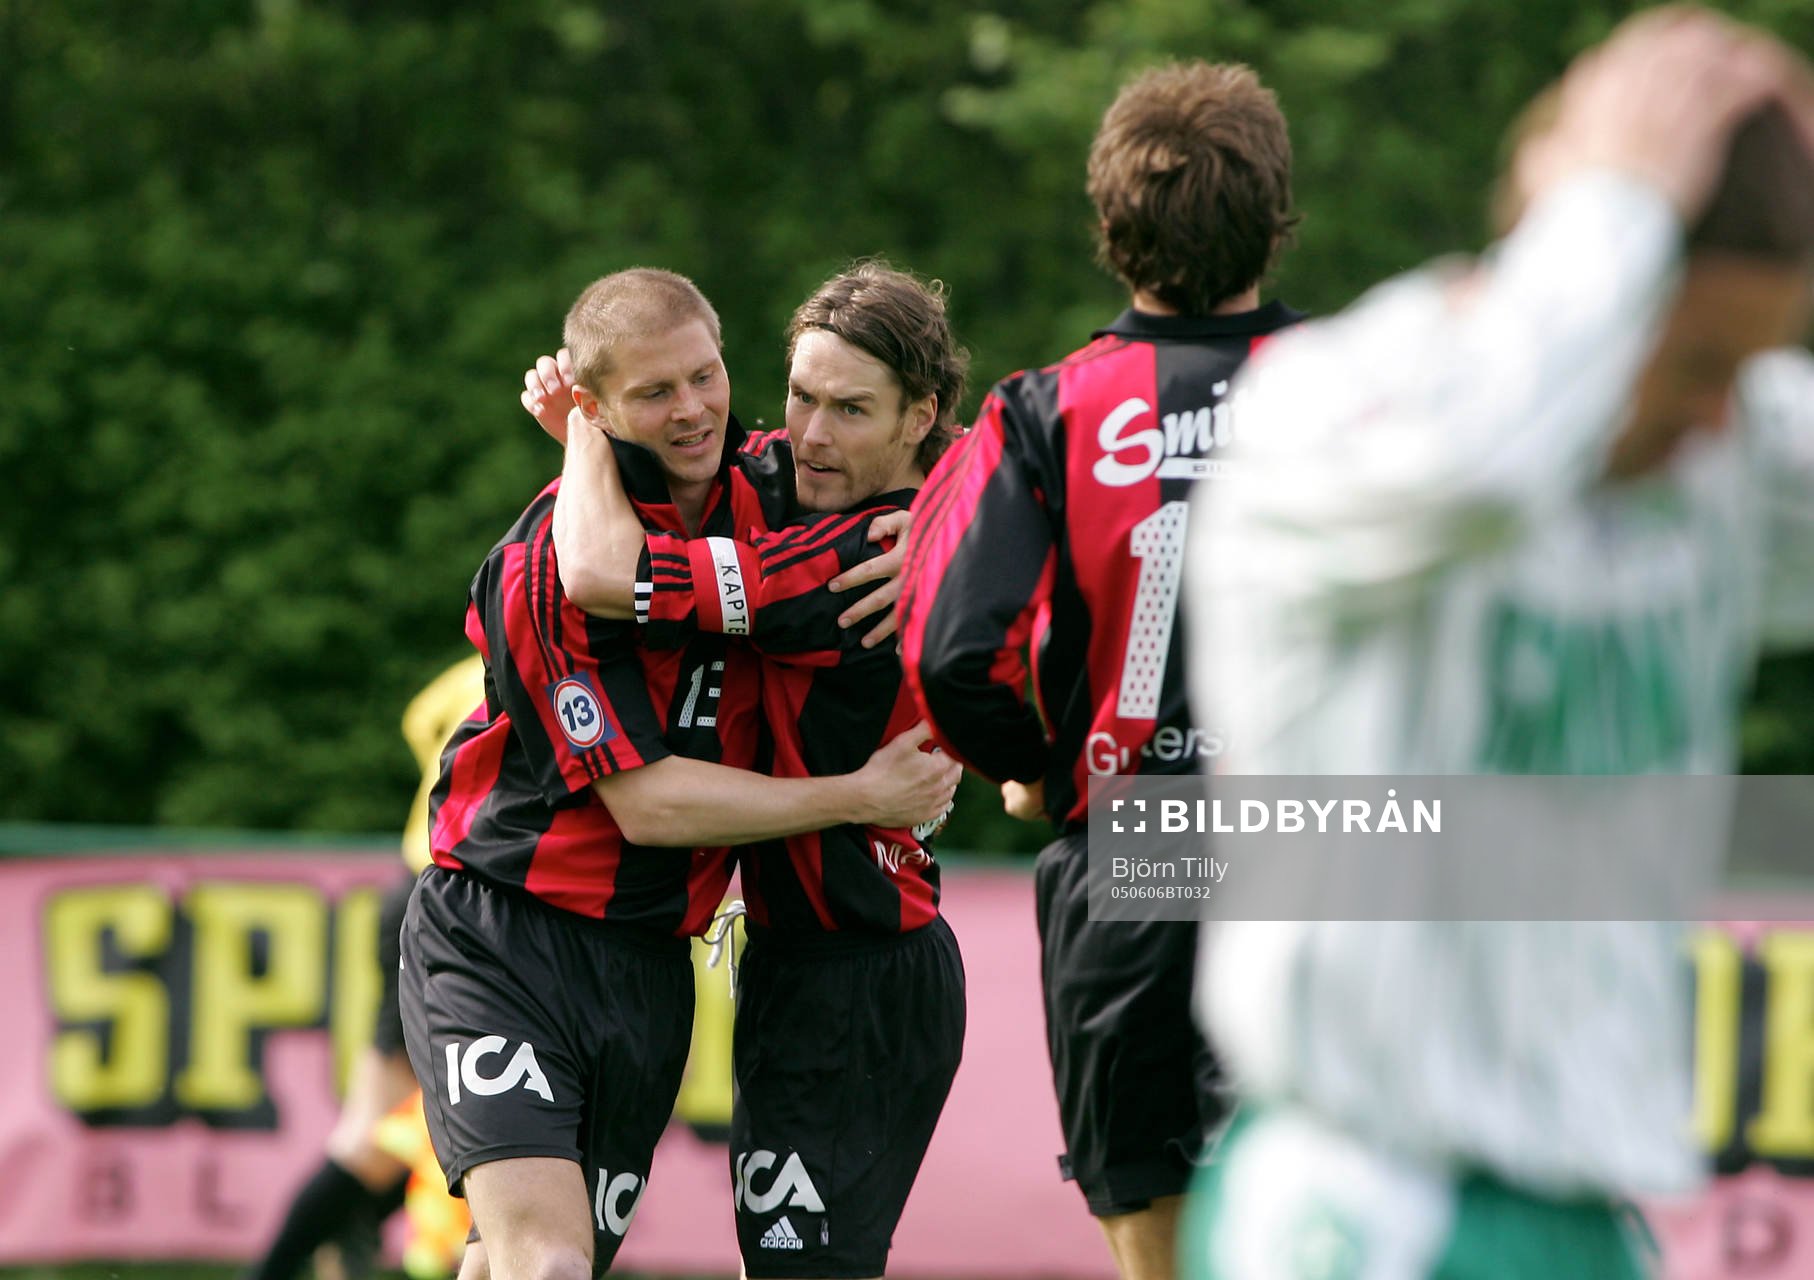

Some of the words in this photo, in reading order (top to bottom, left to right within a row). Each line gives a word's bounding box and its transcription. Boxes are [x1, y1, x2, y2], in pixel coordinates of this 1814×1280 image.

[1092, 379, 1233, 487] Smi
[720, 564, 747, 635] KAPTE
[1116, 501, 1189, 719] 1
[562, 695, 595, 732] 13
[445, 1035, 554, 1106] ICA
[595, 1167, 647, 1236] IC
[735, 1149, 826, 1214] ICA
[760, 1236, 803, 1250] adidas
